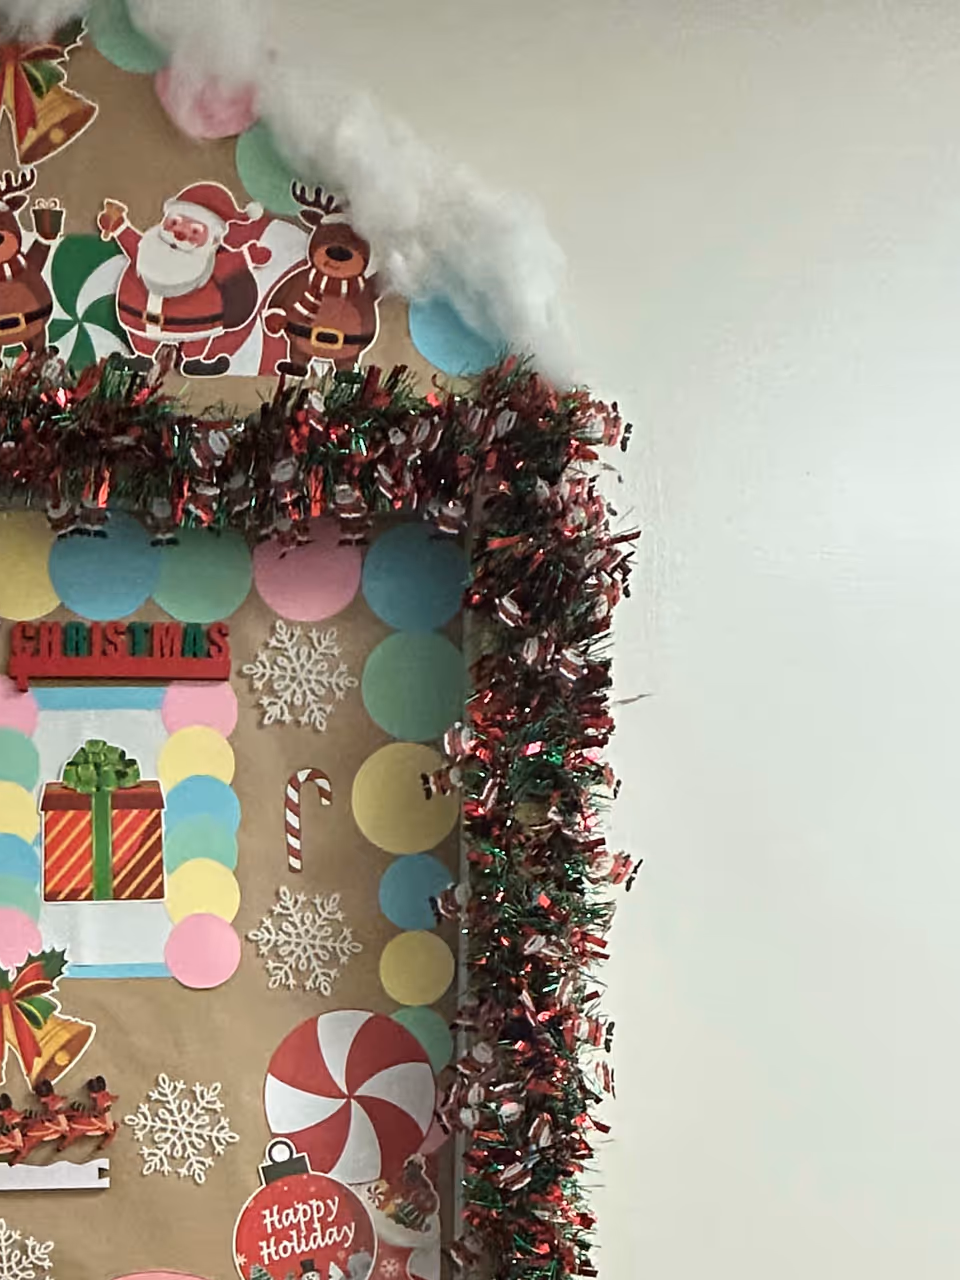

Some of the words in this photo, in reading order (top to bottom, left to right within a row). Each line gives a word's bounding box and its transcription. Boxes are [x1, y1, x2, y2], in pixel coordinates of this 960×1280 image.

[11, 621, 230, 659] CHRISTMAS
[261, 1196, 340, 1234] Happy
[258, 1221, 356, 1265] Holiday
